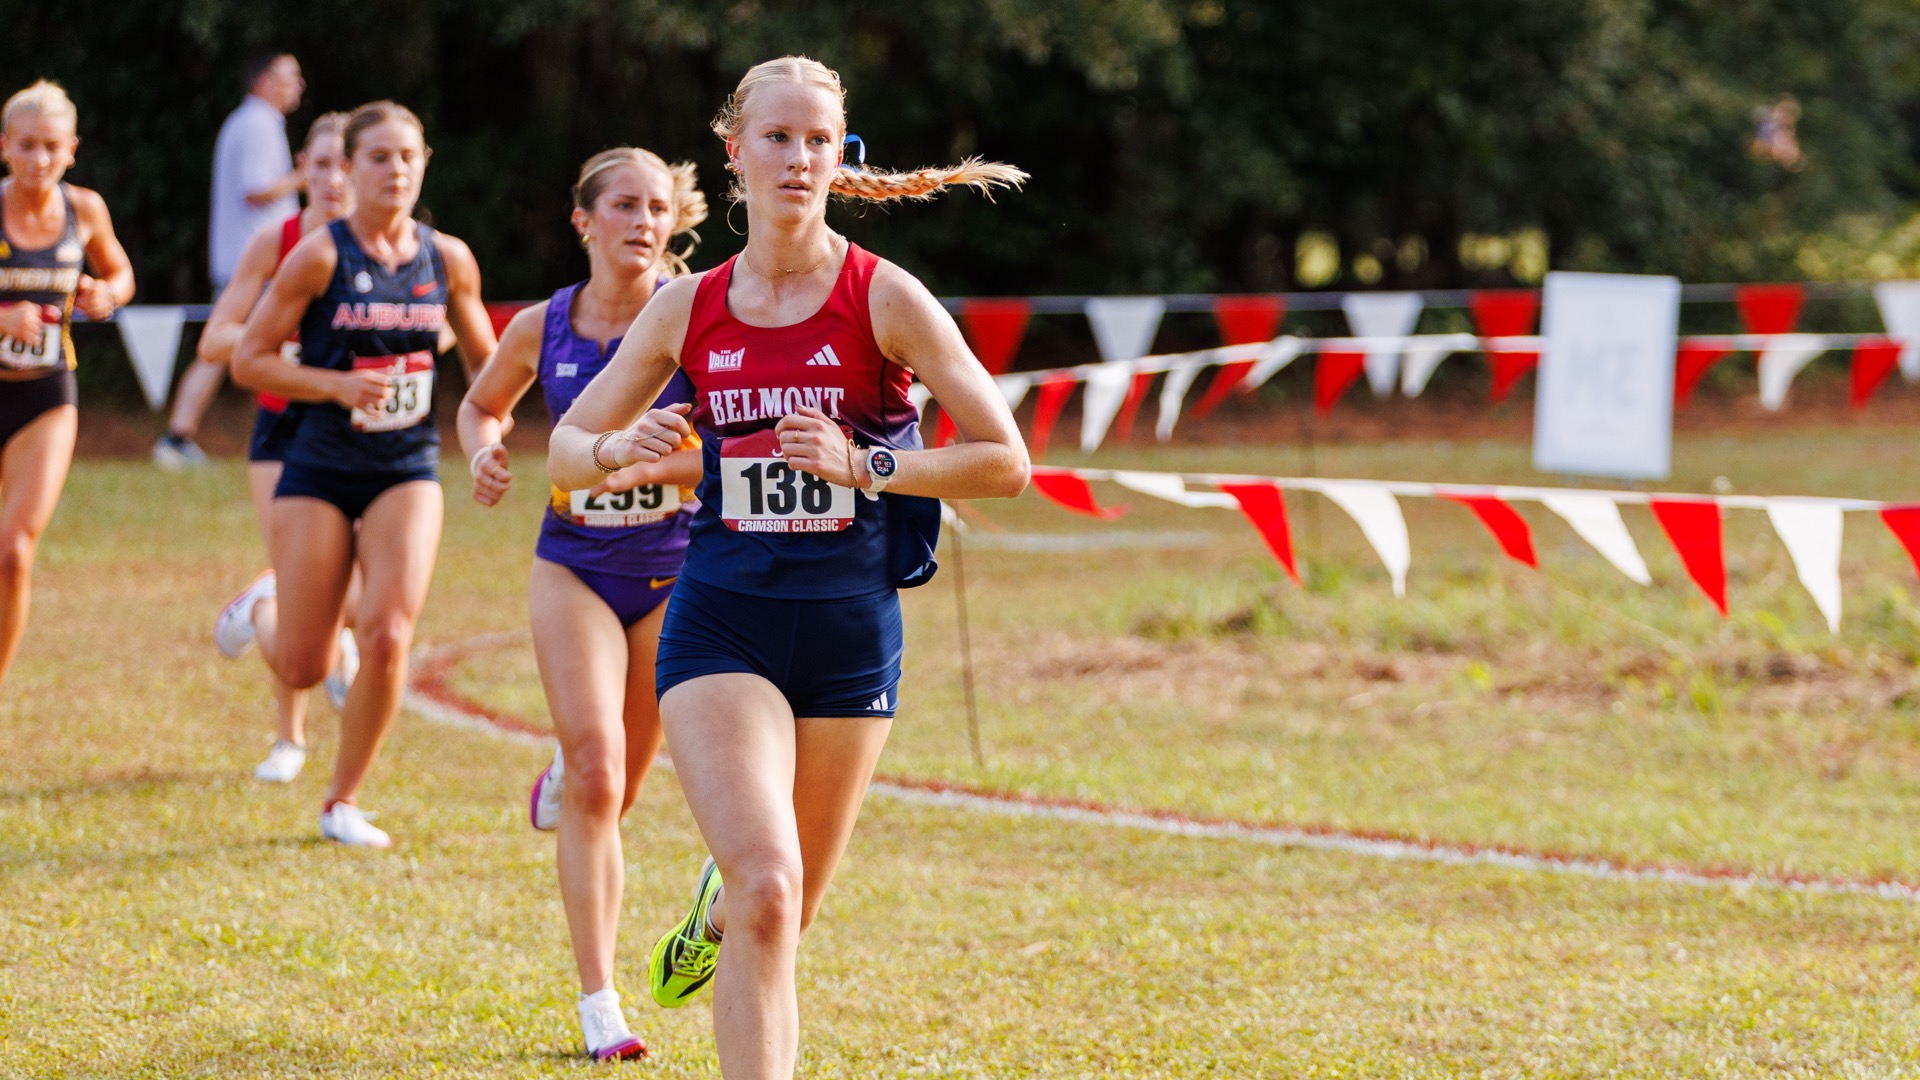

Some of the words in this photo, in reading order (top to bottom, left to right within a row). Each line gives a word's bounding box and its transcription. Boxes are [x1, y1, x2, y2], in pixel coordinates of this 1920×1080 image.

[709, 347, 746, 369] VALLEY
[708, 386, 844, 426] BELMONT
[740, 461, 832, 515] 138
[737, 519, 789, 533] CRIMSON
[791, 518, 839, 532] CLASSIC
